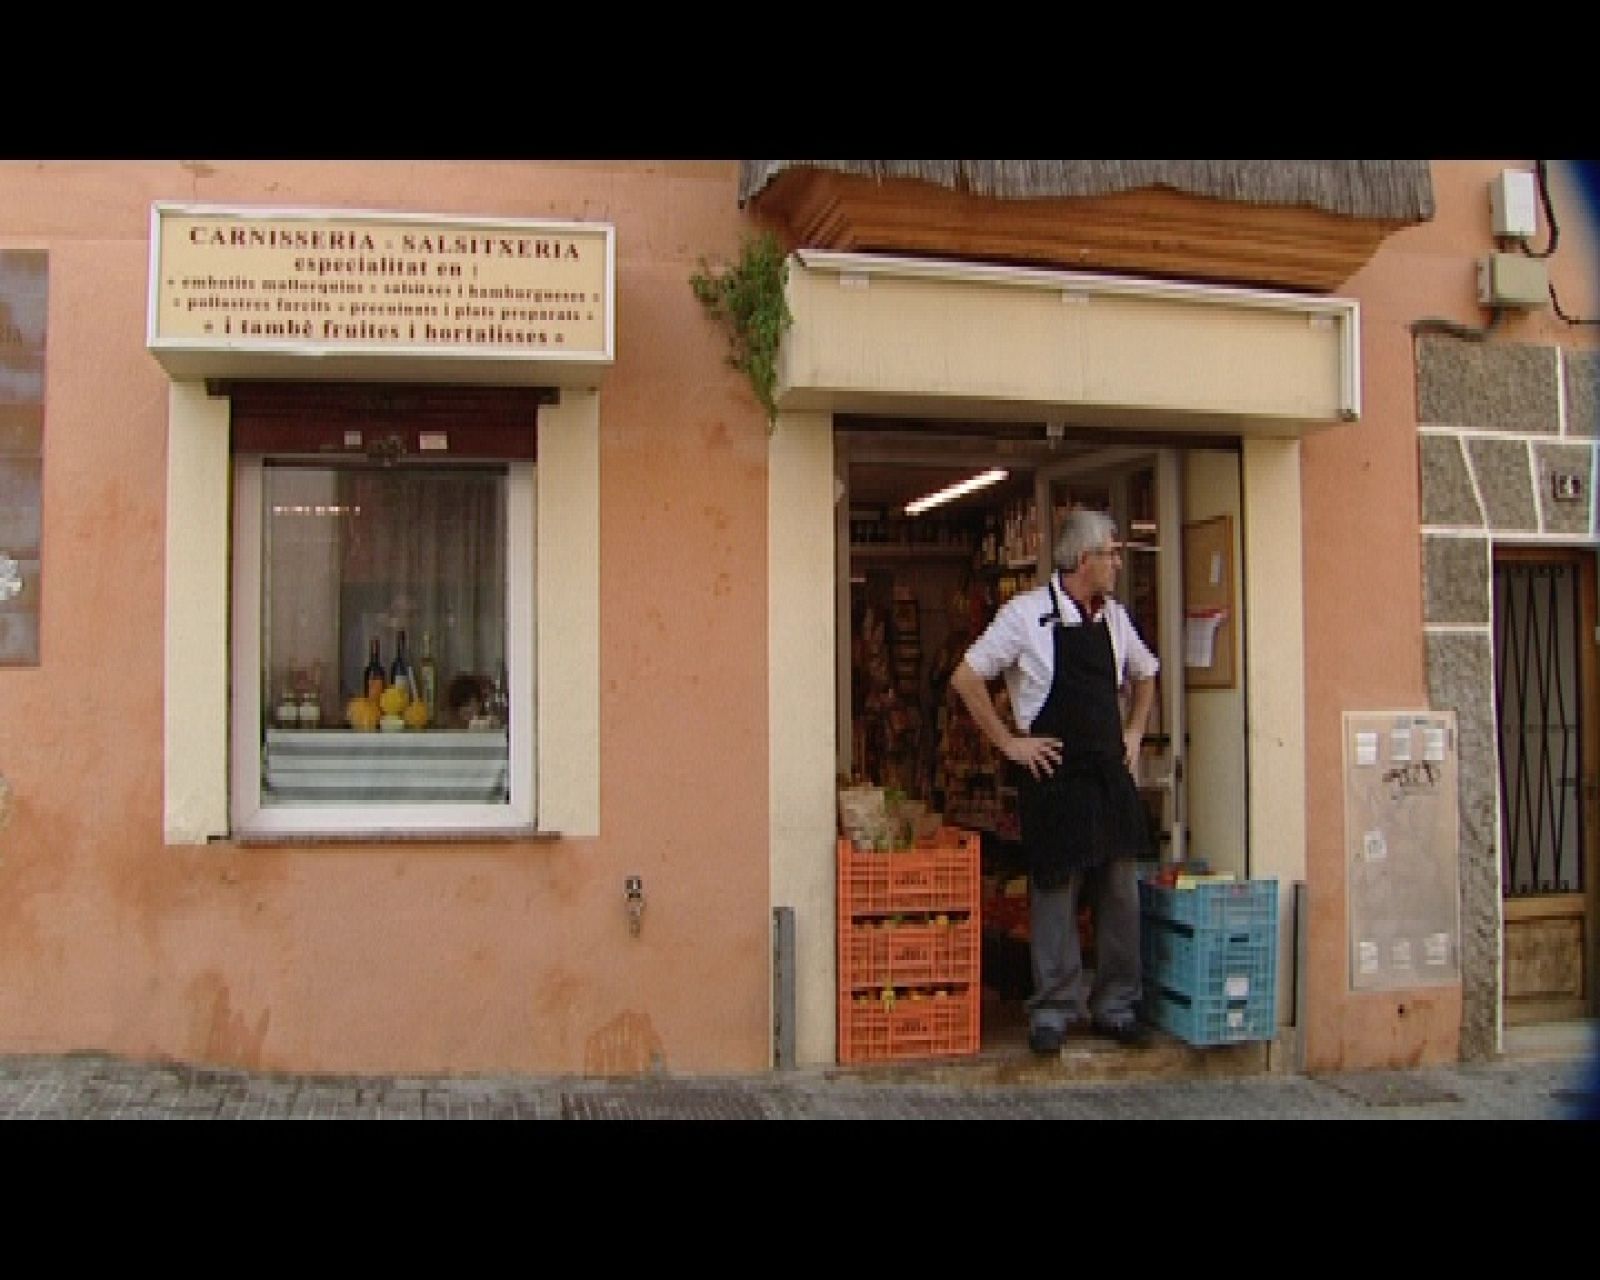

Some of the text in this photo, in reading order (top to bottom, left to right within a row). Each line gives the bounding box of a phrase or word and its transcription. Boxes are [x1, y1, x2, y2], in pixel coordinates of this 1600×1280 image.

[190, 226, 579, 260] CARNISSERIA SALSITXERIA
[295, 257, 461, 277] especialitat en
[323, 319, 399, 339] fruites
[426, 323, 547, 342] hortalisses
